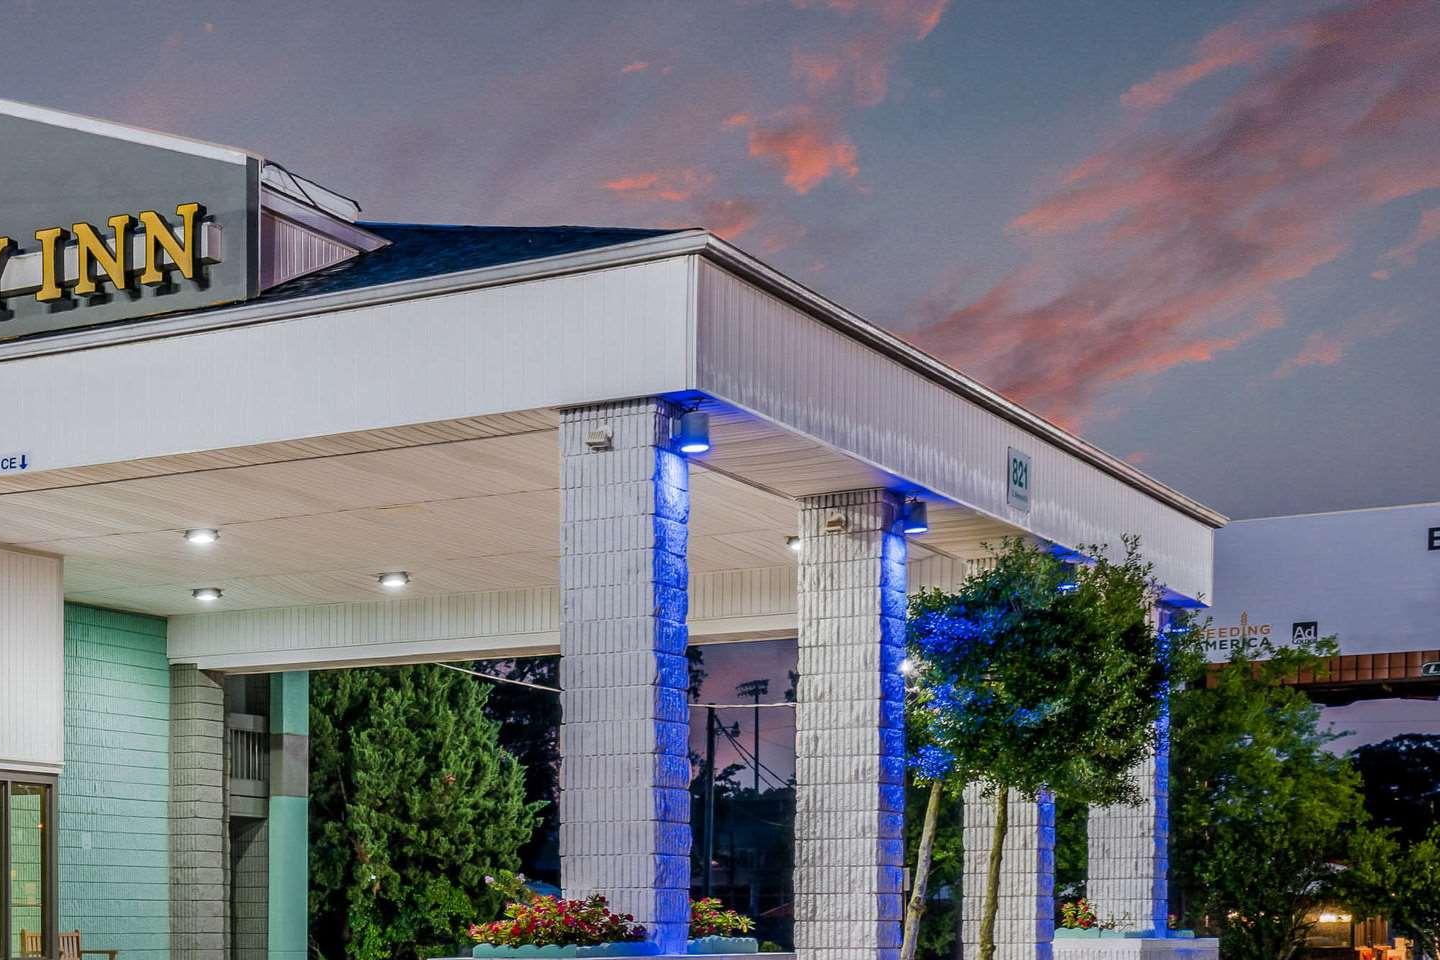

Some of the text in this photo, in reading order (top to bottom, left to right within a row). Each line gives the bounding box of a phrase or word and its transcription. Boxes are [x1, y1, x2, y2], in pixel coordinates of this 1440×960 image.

[35, 202, 202, 302] INN
[1012, 458, 1028, 490] 821
[1198, 624, 1271, 639] EEDING
